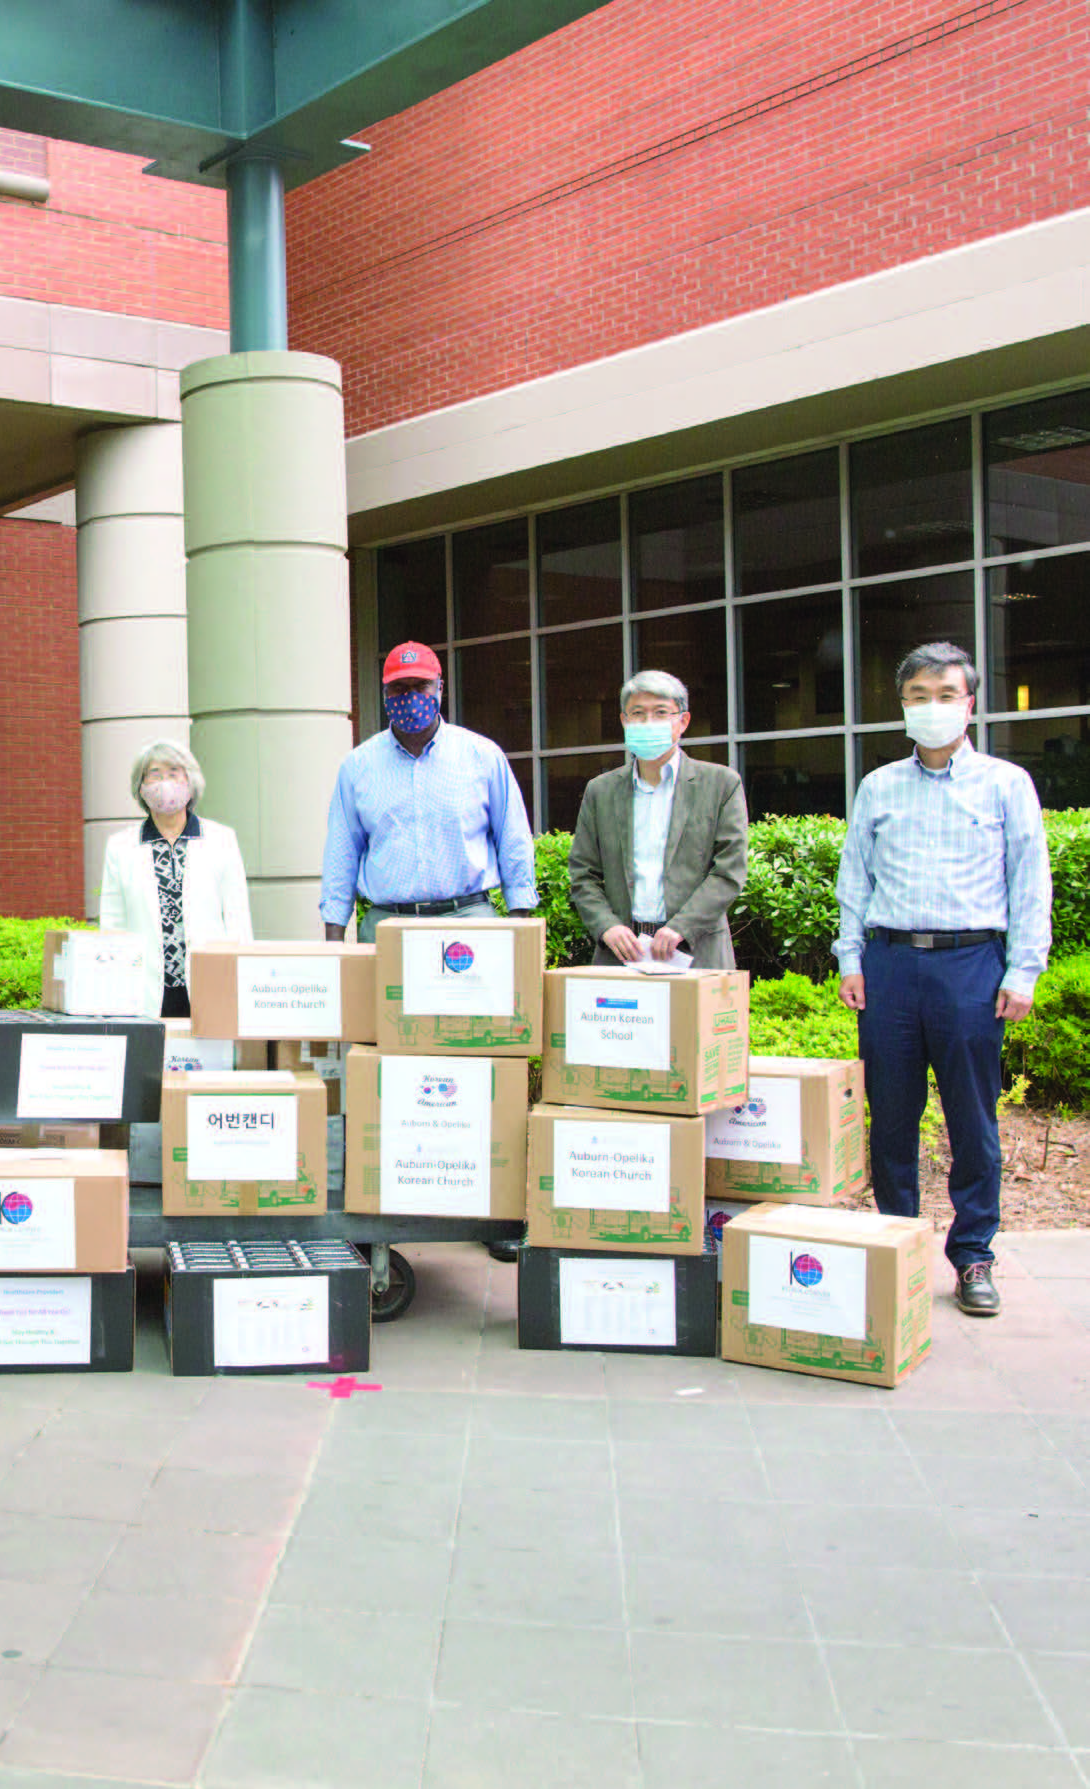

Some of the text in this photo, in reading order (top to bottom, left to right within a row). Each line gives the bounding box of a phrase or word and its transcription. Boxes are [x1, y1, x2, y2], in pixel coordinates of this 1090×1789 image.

[251, 984, 327, 995] Auburn-Opelika
[254, 1000, 325, 1009] Korean Church
[581, 1012, 654, 1025] Auburn Korean
[601, 1030, 633, 1041] School
[208, 1112, 275, 1130] 어번캔디
[570, 1151, 654, 1164] Auburn-Opelika
[395, 1160, 476, 1171] Auburn-Opelika
[572, 1168, 652, 1181] Korean Church
[397, 1176, 474, 1187] Korean Church
